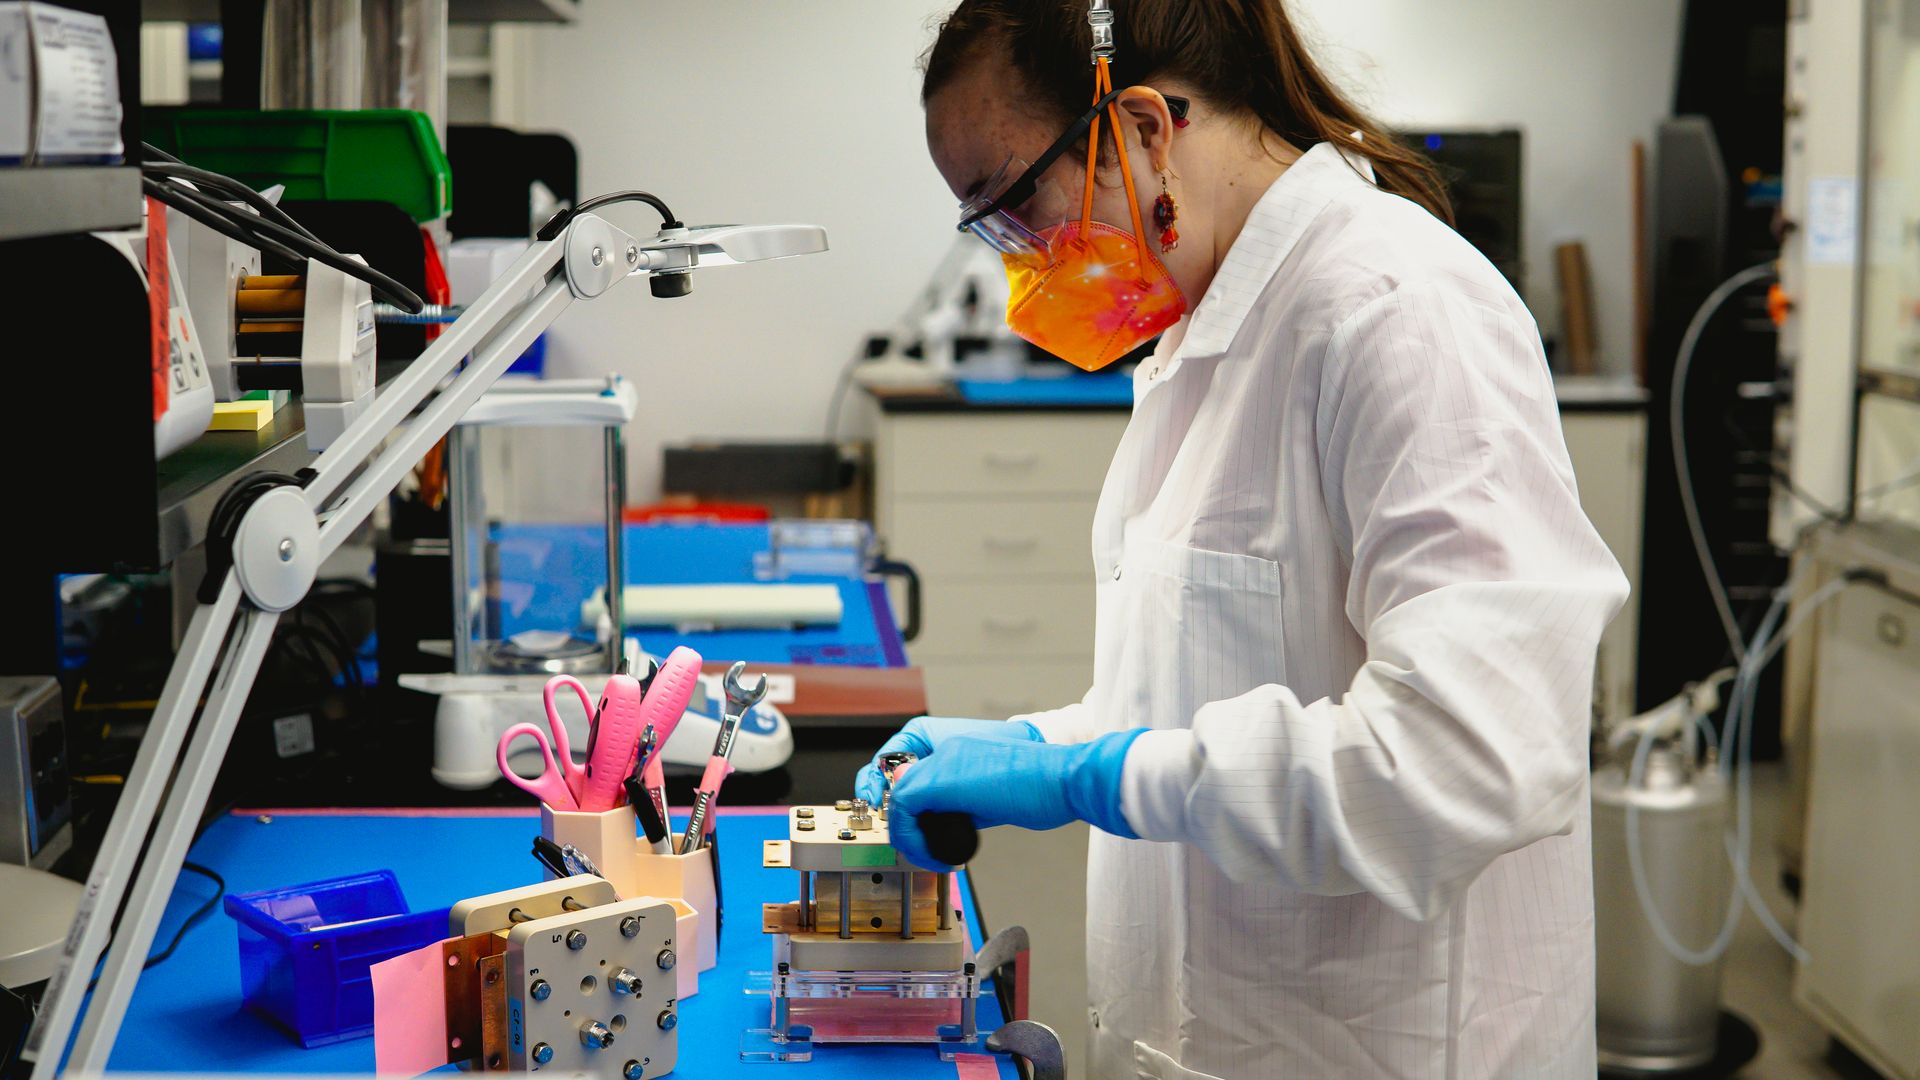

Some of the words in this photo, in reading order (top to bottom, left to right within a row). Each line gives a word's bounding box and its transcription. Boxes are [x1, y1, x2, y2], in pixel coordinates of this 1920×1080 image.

[552, 934, 562, 944] 5
[664, 938, 672, 946] 2
[530, 967, 540, 977] 3
[666, 998, 676, 1008] 4
